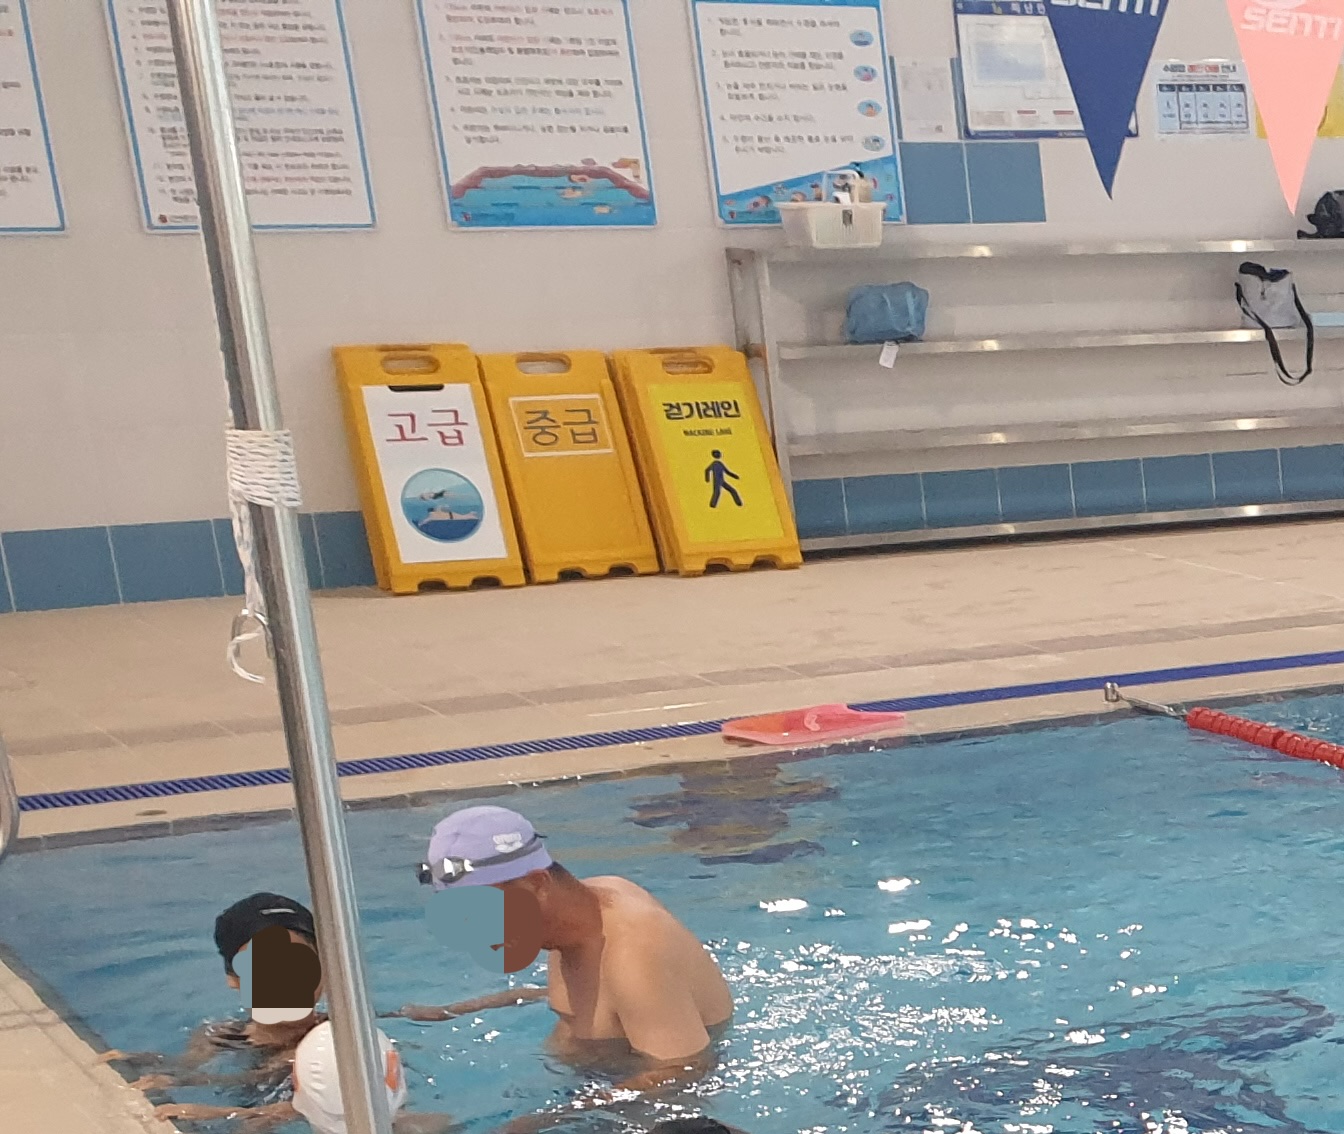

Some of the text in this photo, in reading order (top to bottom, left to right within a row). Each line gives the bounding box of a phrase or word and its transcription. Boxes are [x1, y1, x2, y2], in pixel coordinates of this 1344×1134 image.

[1241, 8, 1343, 41] SENTI
[386, 408, 468, 447] 고급
[524, 408, 599, 446] 중급
[662, 400, 741, 421] 걷기레인
